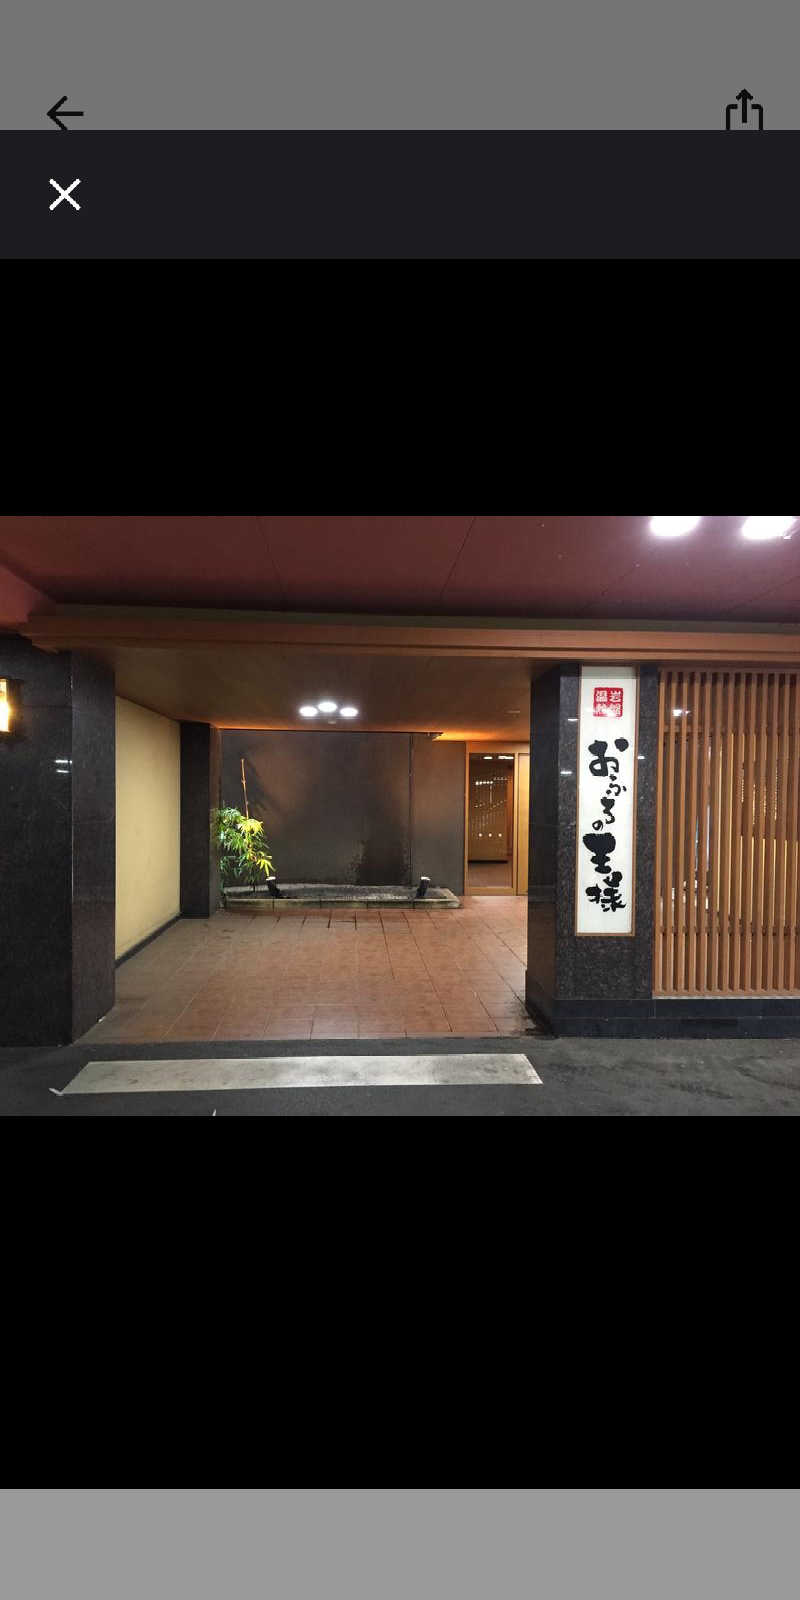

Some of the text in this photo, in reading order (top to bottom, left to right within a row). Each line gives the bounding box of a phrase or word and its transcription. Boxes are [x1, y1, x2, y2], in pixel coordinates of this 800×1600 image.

[583, 738, 628, 912] おふろの王様
